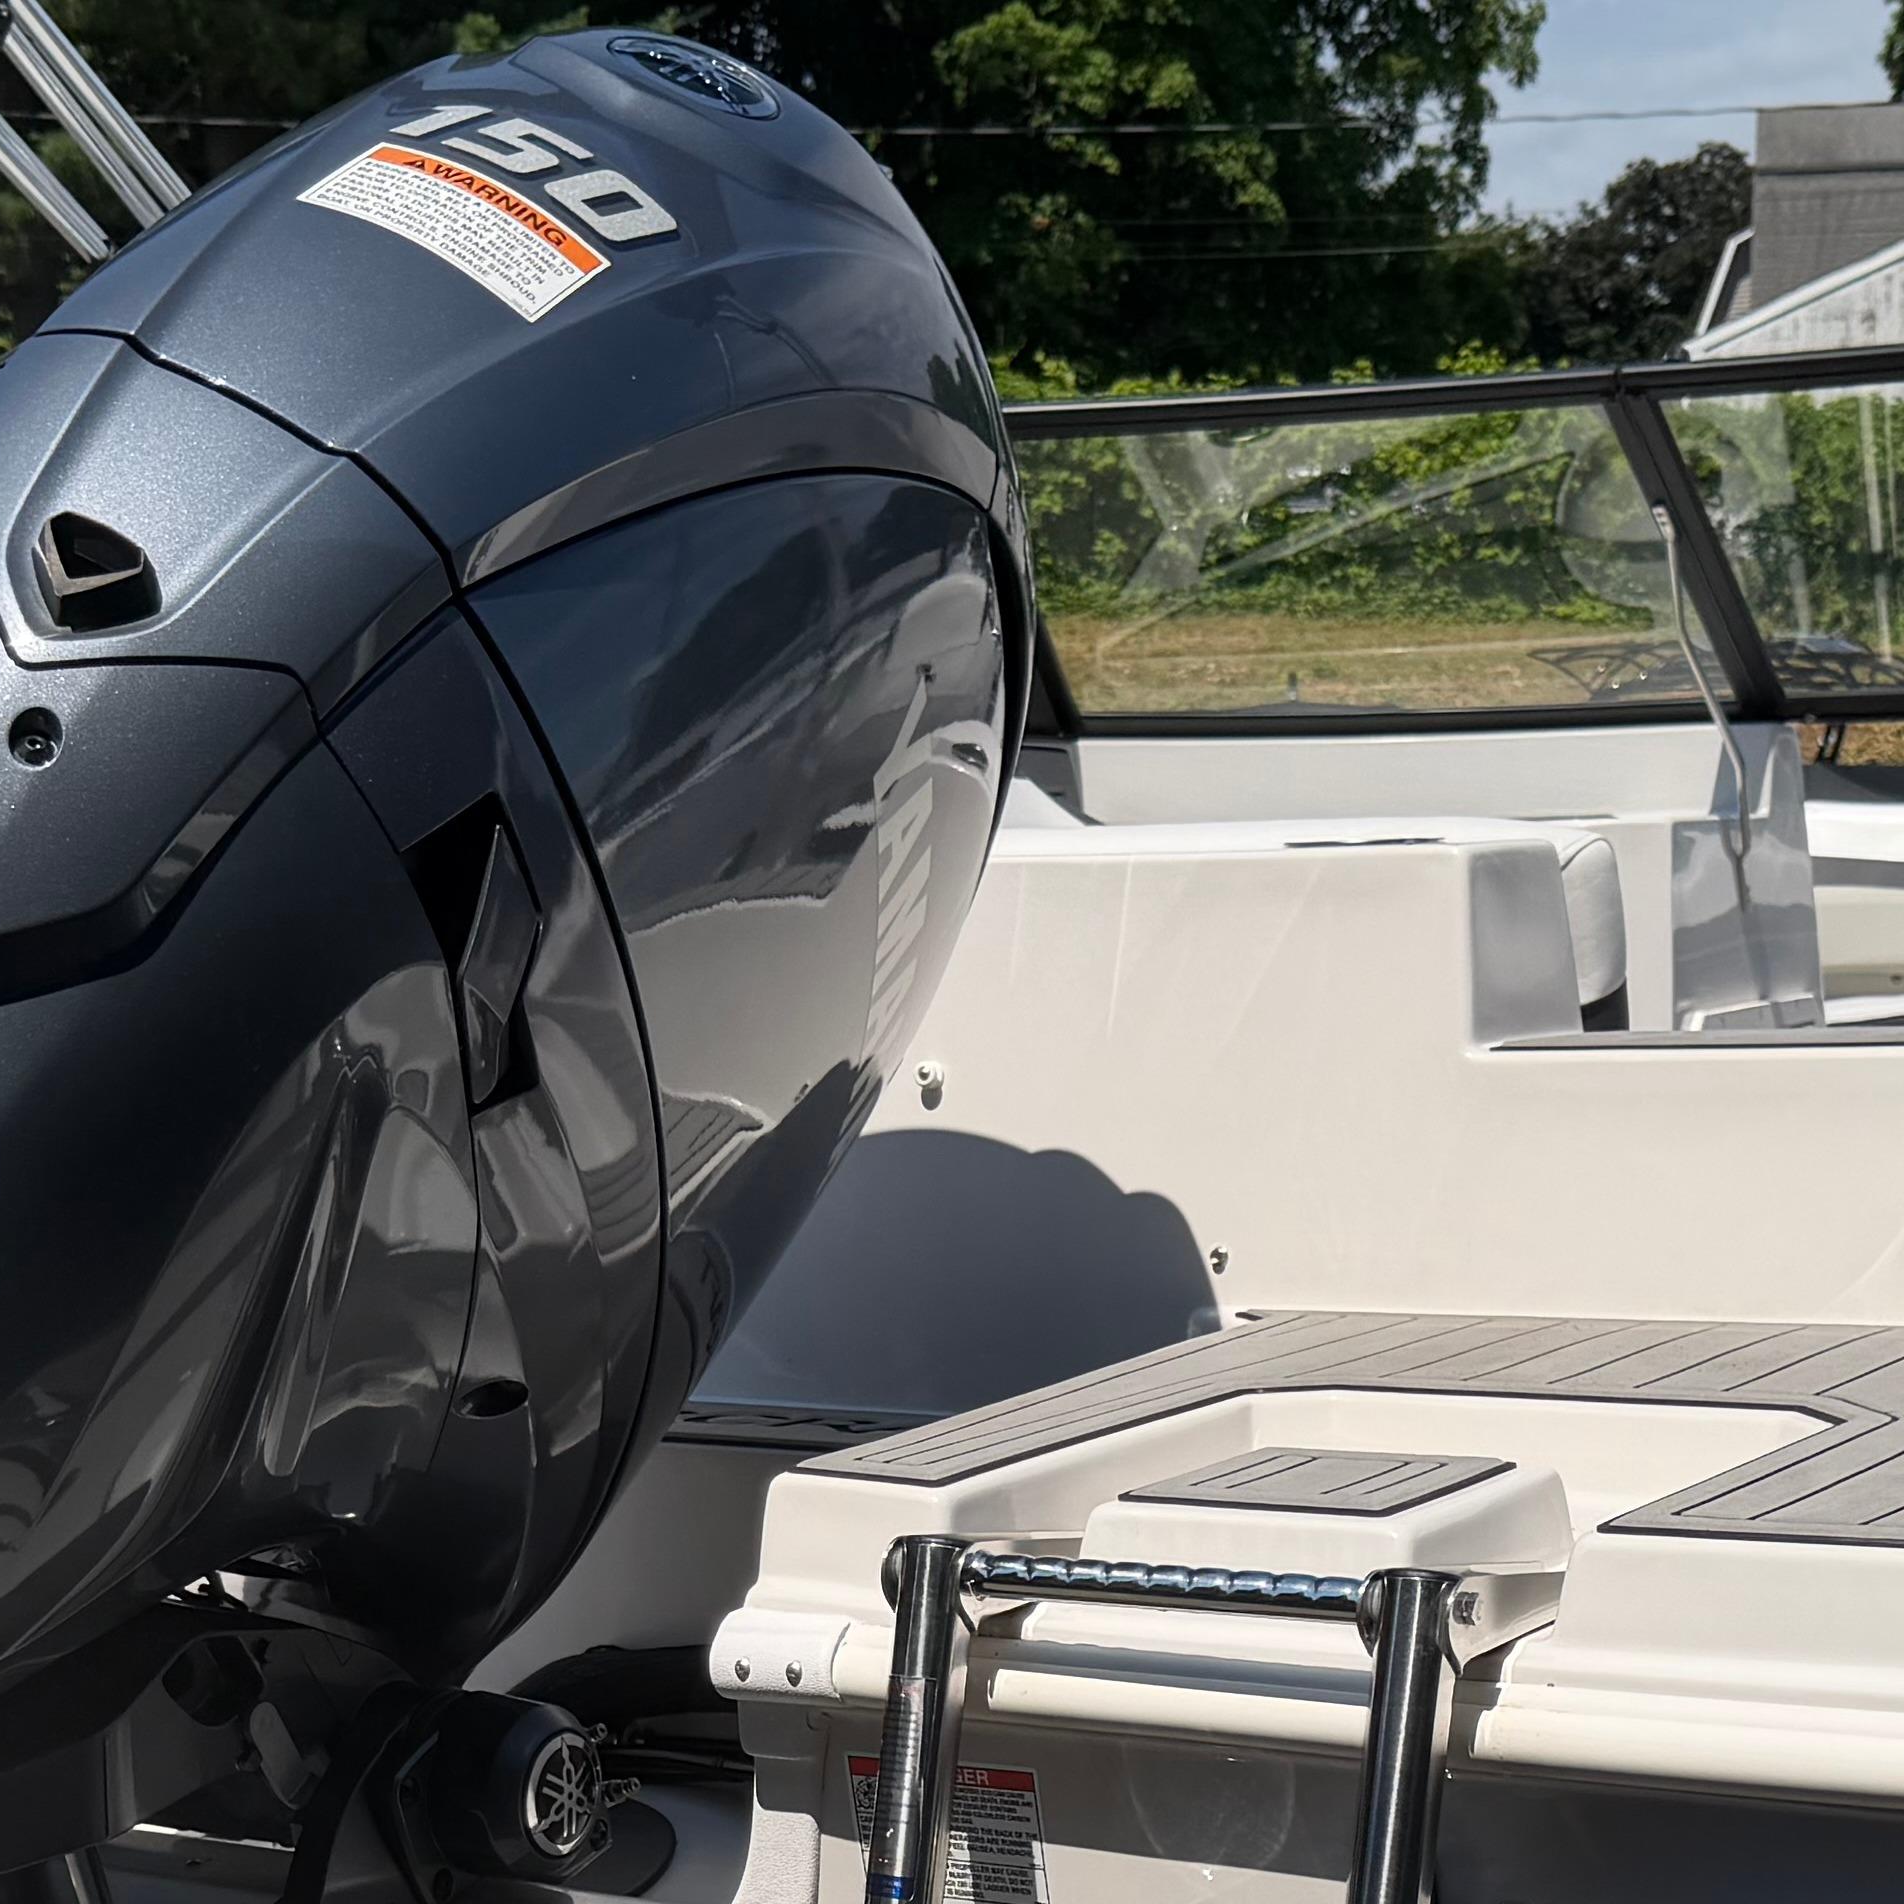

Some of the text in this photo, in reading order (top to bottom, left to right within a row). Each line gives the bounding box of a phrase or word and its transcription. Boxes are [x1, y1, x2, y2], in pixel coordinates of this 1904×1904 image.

[389, 105, 678, 242] 150
[372, 210, 439, 243] PROPERTY
[427, 163, 570, 246] WARNING
[397, 202, 442, 225] INJURY
[441, 223, 461, 235] OR
[461, 235, 515, 271] DAMAGE
[514, 272, 533, 286] TO
[439, 232, 488, 263] ENGINE
[459, 223, 486, 240] MAY
[484, 239, 533, 274] RESULT
[483, 207, 513, 226] TRIM
[511, 225, 559, 260] LIMITER
[557, 260, 576, 275] TO
[493, 234, 519, 252] THE
[517, 251, 548, 275] TRIM
